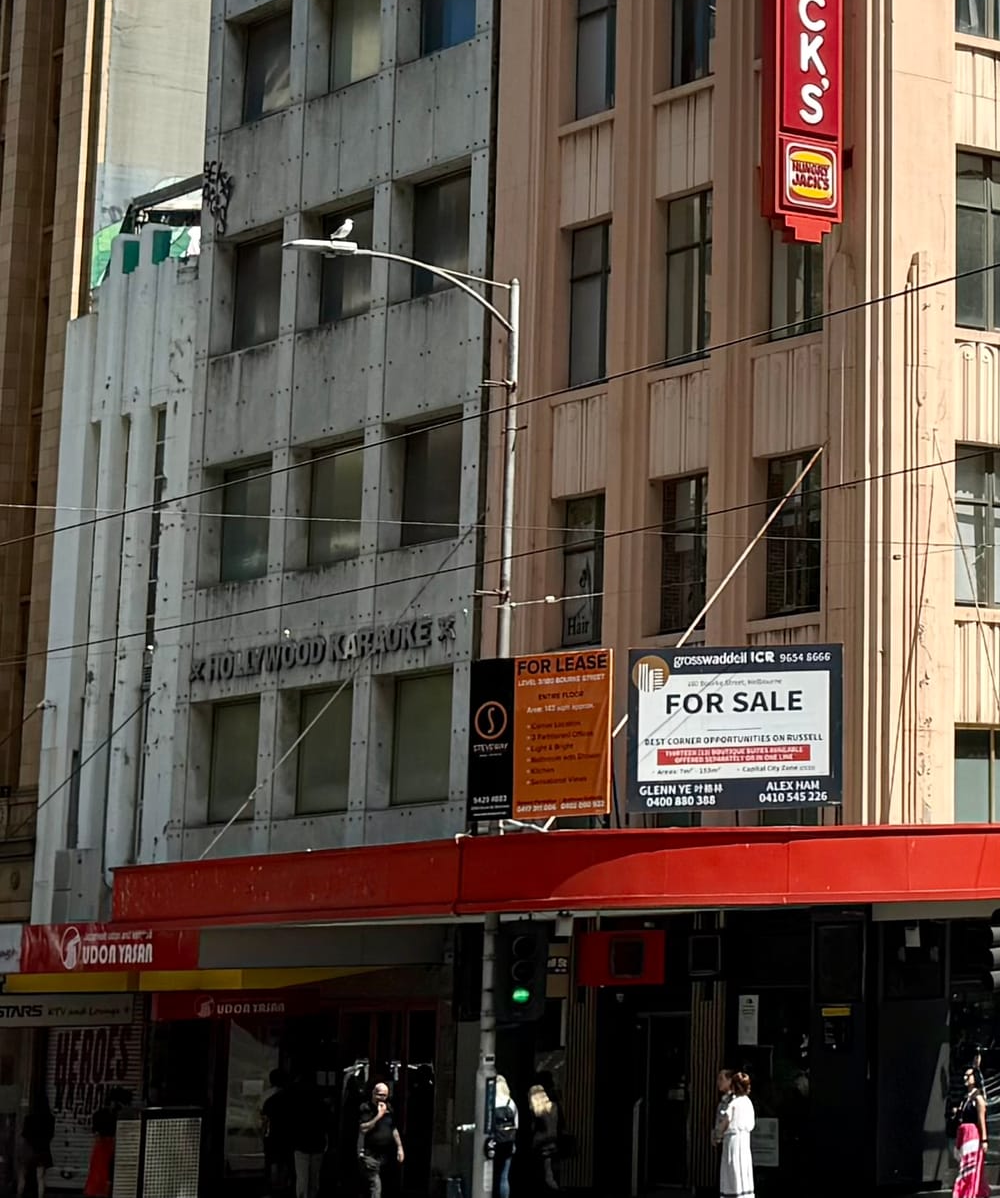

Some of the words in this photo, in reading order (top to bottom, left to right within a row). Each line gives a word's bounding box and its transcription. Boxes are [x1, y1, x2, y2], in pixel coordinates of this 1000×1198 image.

[791, 160, 829, 177] HUNGRY
[791, 172, 830, 191] JACK'S
[567, 616, 589, 636] Hair
[209, 634, 327, 682] HOLLYWOOD
[328, 618, 433, 662] KARAOKE
[750, 651, 775, 663] ICR
[779, 653, 804, 663] 9654
[517, 658, 551, 676] FOR
[556, 653, 608, 673] LEASE
[665, 692, 724, 715] FOR
[732, 690, 804, 713] SALE
[644, 737, 666, 746] BEST
[667, 736, 704, 745] CORNER
[704, 734, 772, 744] OPPORTUNITIES
[772, 734, 786, 743] ON
[786, 733, 823, 742] RUSSELL
[674, 756, 704, 764] OFFERED
[764, 754, 779, 762] ONE
[742, 765, 766, 773] Capital
[766, 765, 780, 773] City
[780, 764, 798, 772] Zone
[639, 785, 677, 797] GLENN
[678, 784, 693, 796] YE
[766, 781, 794, 792] ALEX
[795, 780, 820, 791] HAM
[646, 796, 673, 808] 0400
[758, 792, 785, 804] 0410
[785, 791, 807, 803] 545
[807, 791, 829, 802] 226
[82, 945, 116, 964] UDON
[118, 943, 153, 963] YASAN
[217, 1003, 251, 1015] UDON
